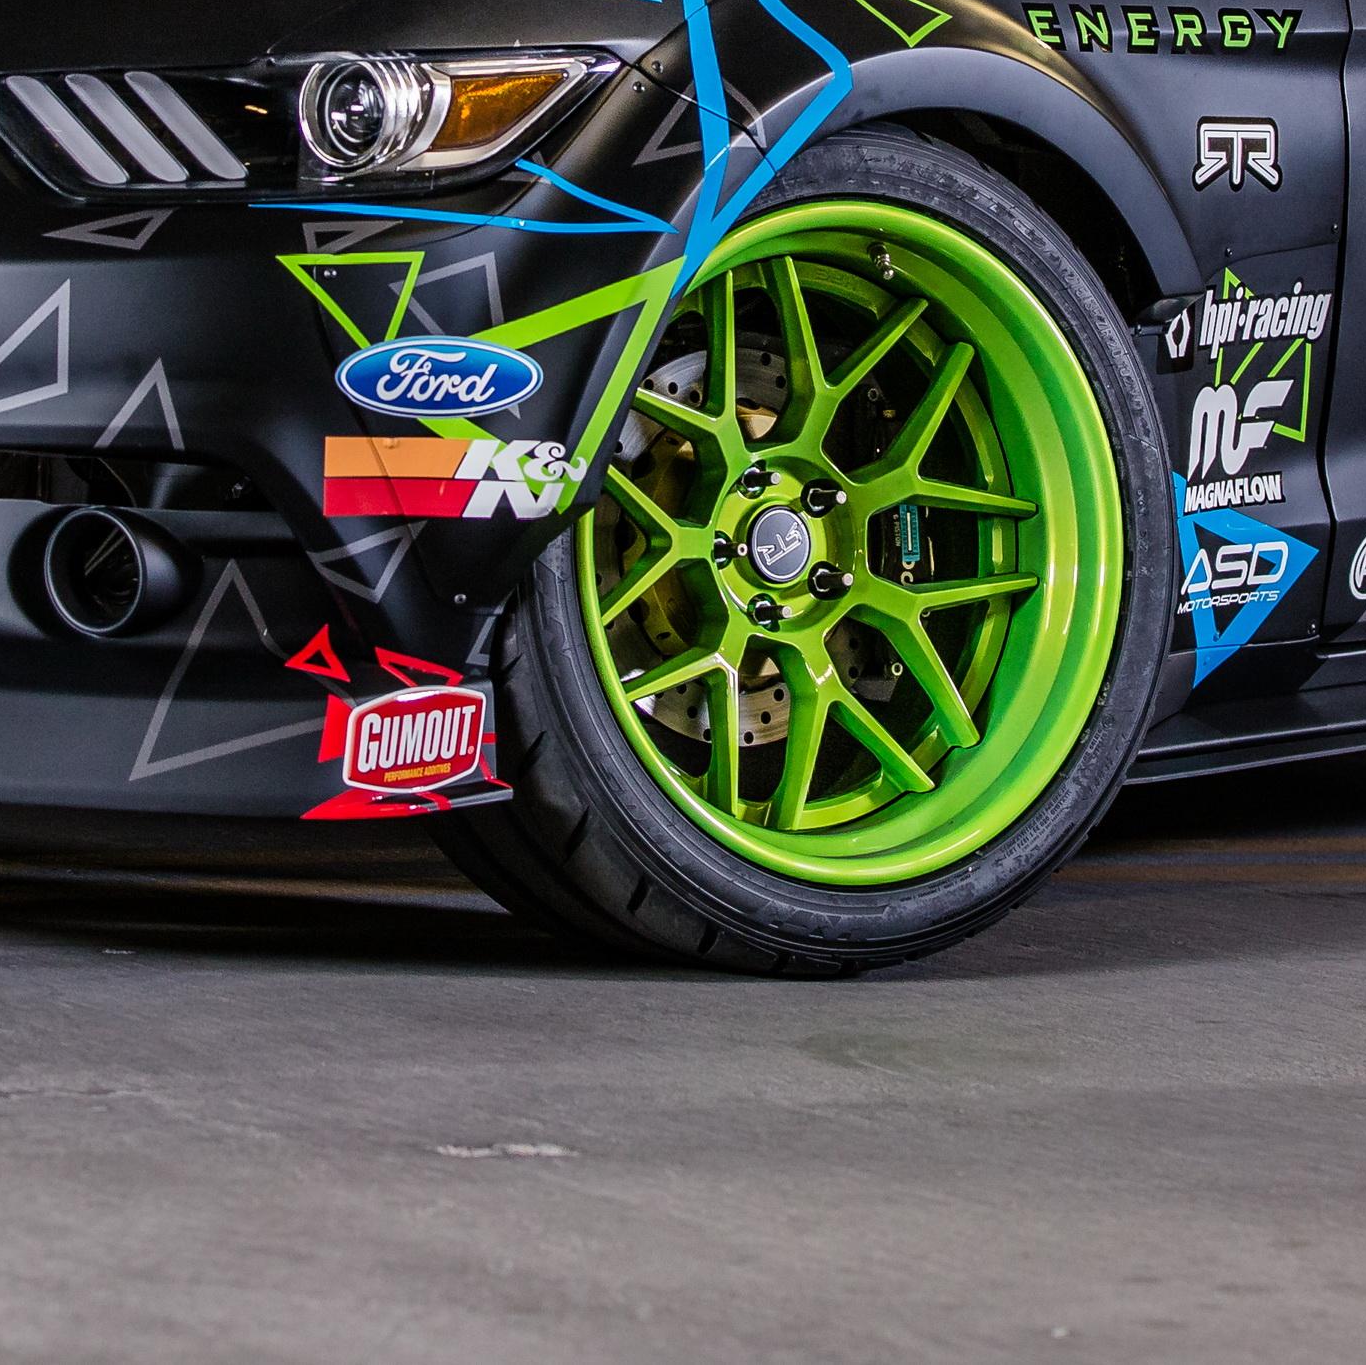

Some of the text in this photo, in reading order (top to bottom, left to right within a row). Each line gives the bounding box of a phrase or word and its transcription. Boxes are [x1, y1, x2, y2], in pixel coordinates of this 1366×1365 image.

[1028, 8, 1296, 50] ENERGY
[375, 348, 497, 403] Ford
[1184, 474, 1282, 512] MAGNAFLOW
[1180, 541, 1290, 597] ASD
[1176, 589, 1281, 615] MOTORSPORTS
[357, 705, 477, 773] GUMOUT
[383, 768, 424, 783] PERFORMANCE
